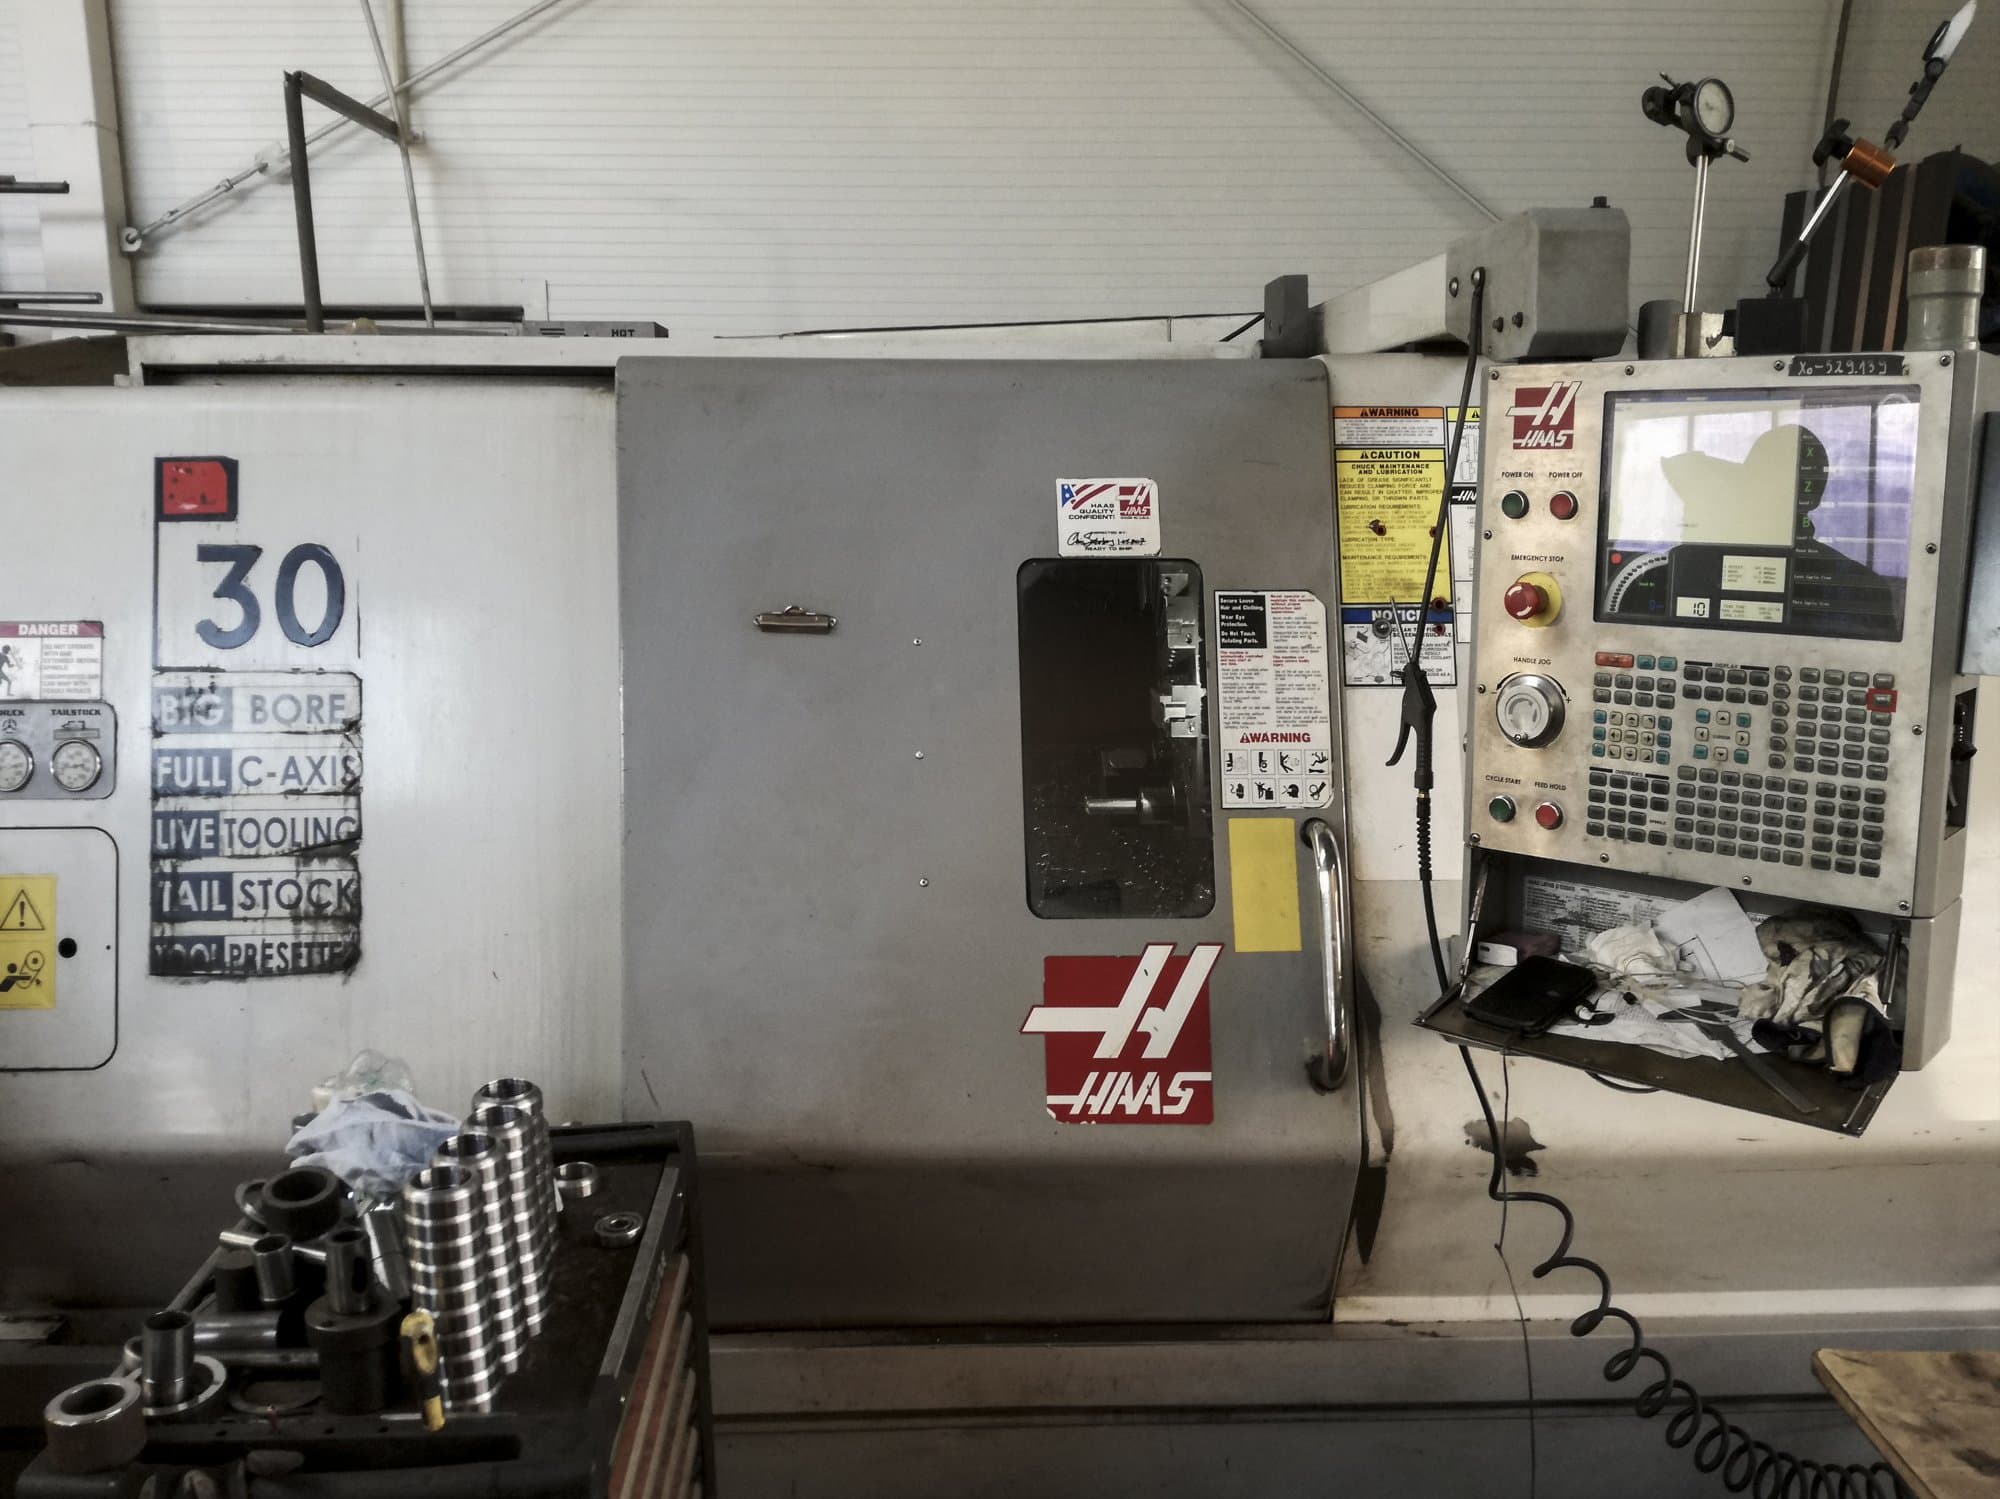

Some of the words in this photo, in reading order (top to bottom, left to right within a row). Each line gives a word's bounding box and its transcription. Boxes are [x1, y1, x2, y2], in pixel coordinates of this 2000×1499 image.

[1369, 408, 1419, 417] WARNING
[1513, 430, 1574, 447] HAAS
[1370, 450, 1420, 459] CAUTION
[1806, 447, 1814, 457] X
[1804, 481, 1812, 493] Z
[1511, 554, 1548, 562] EMERGENCY
[1549, 554, 1564, 562] STOP
[195, 542, 346, 650] 30
[1693, 601, 1706, 617] 10
[18, 623, 78, 636] DANGER
[1513, 656, 1536, 664] HANDLE
[50, 708, 102, 717] TAILSTOCK
[160, 693, 225, 726] BIG
[250, 693, 347, 727] BORE
[1250, 732, 1311, 743] WARNING
[156, 755, 227, 788] FULL
[238, 754, 356, 787] C-AXIS
[1485, 774, 1504, 783] CYCLE
[1504, 777, 1521, 785] START
[1534, 781, 1548, 789] FEED
[1549, 783, 1567, 791] HOLD
[155, 817, 215, 850] LIVE
[223, 815, 356, 849] TOOLING
[158, 879, 227, 912] TAIL
[238, 878, 355, 911] STOCK
[1046, 1071, 1213, 1116] HAAS
